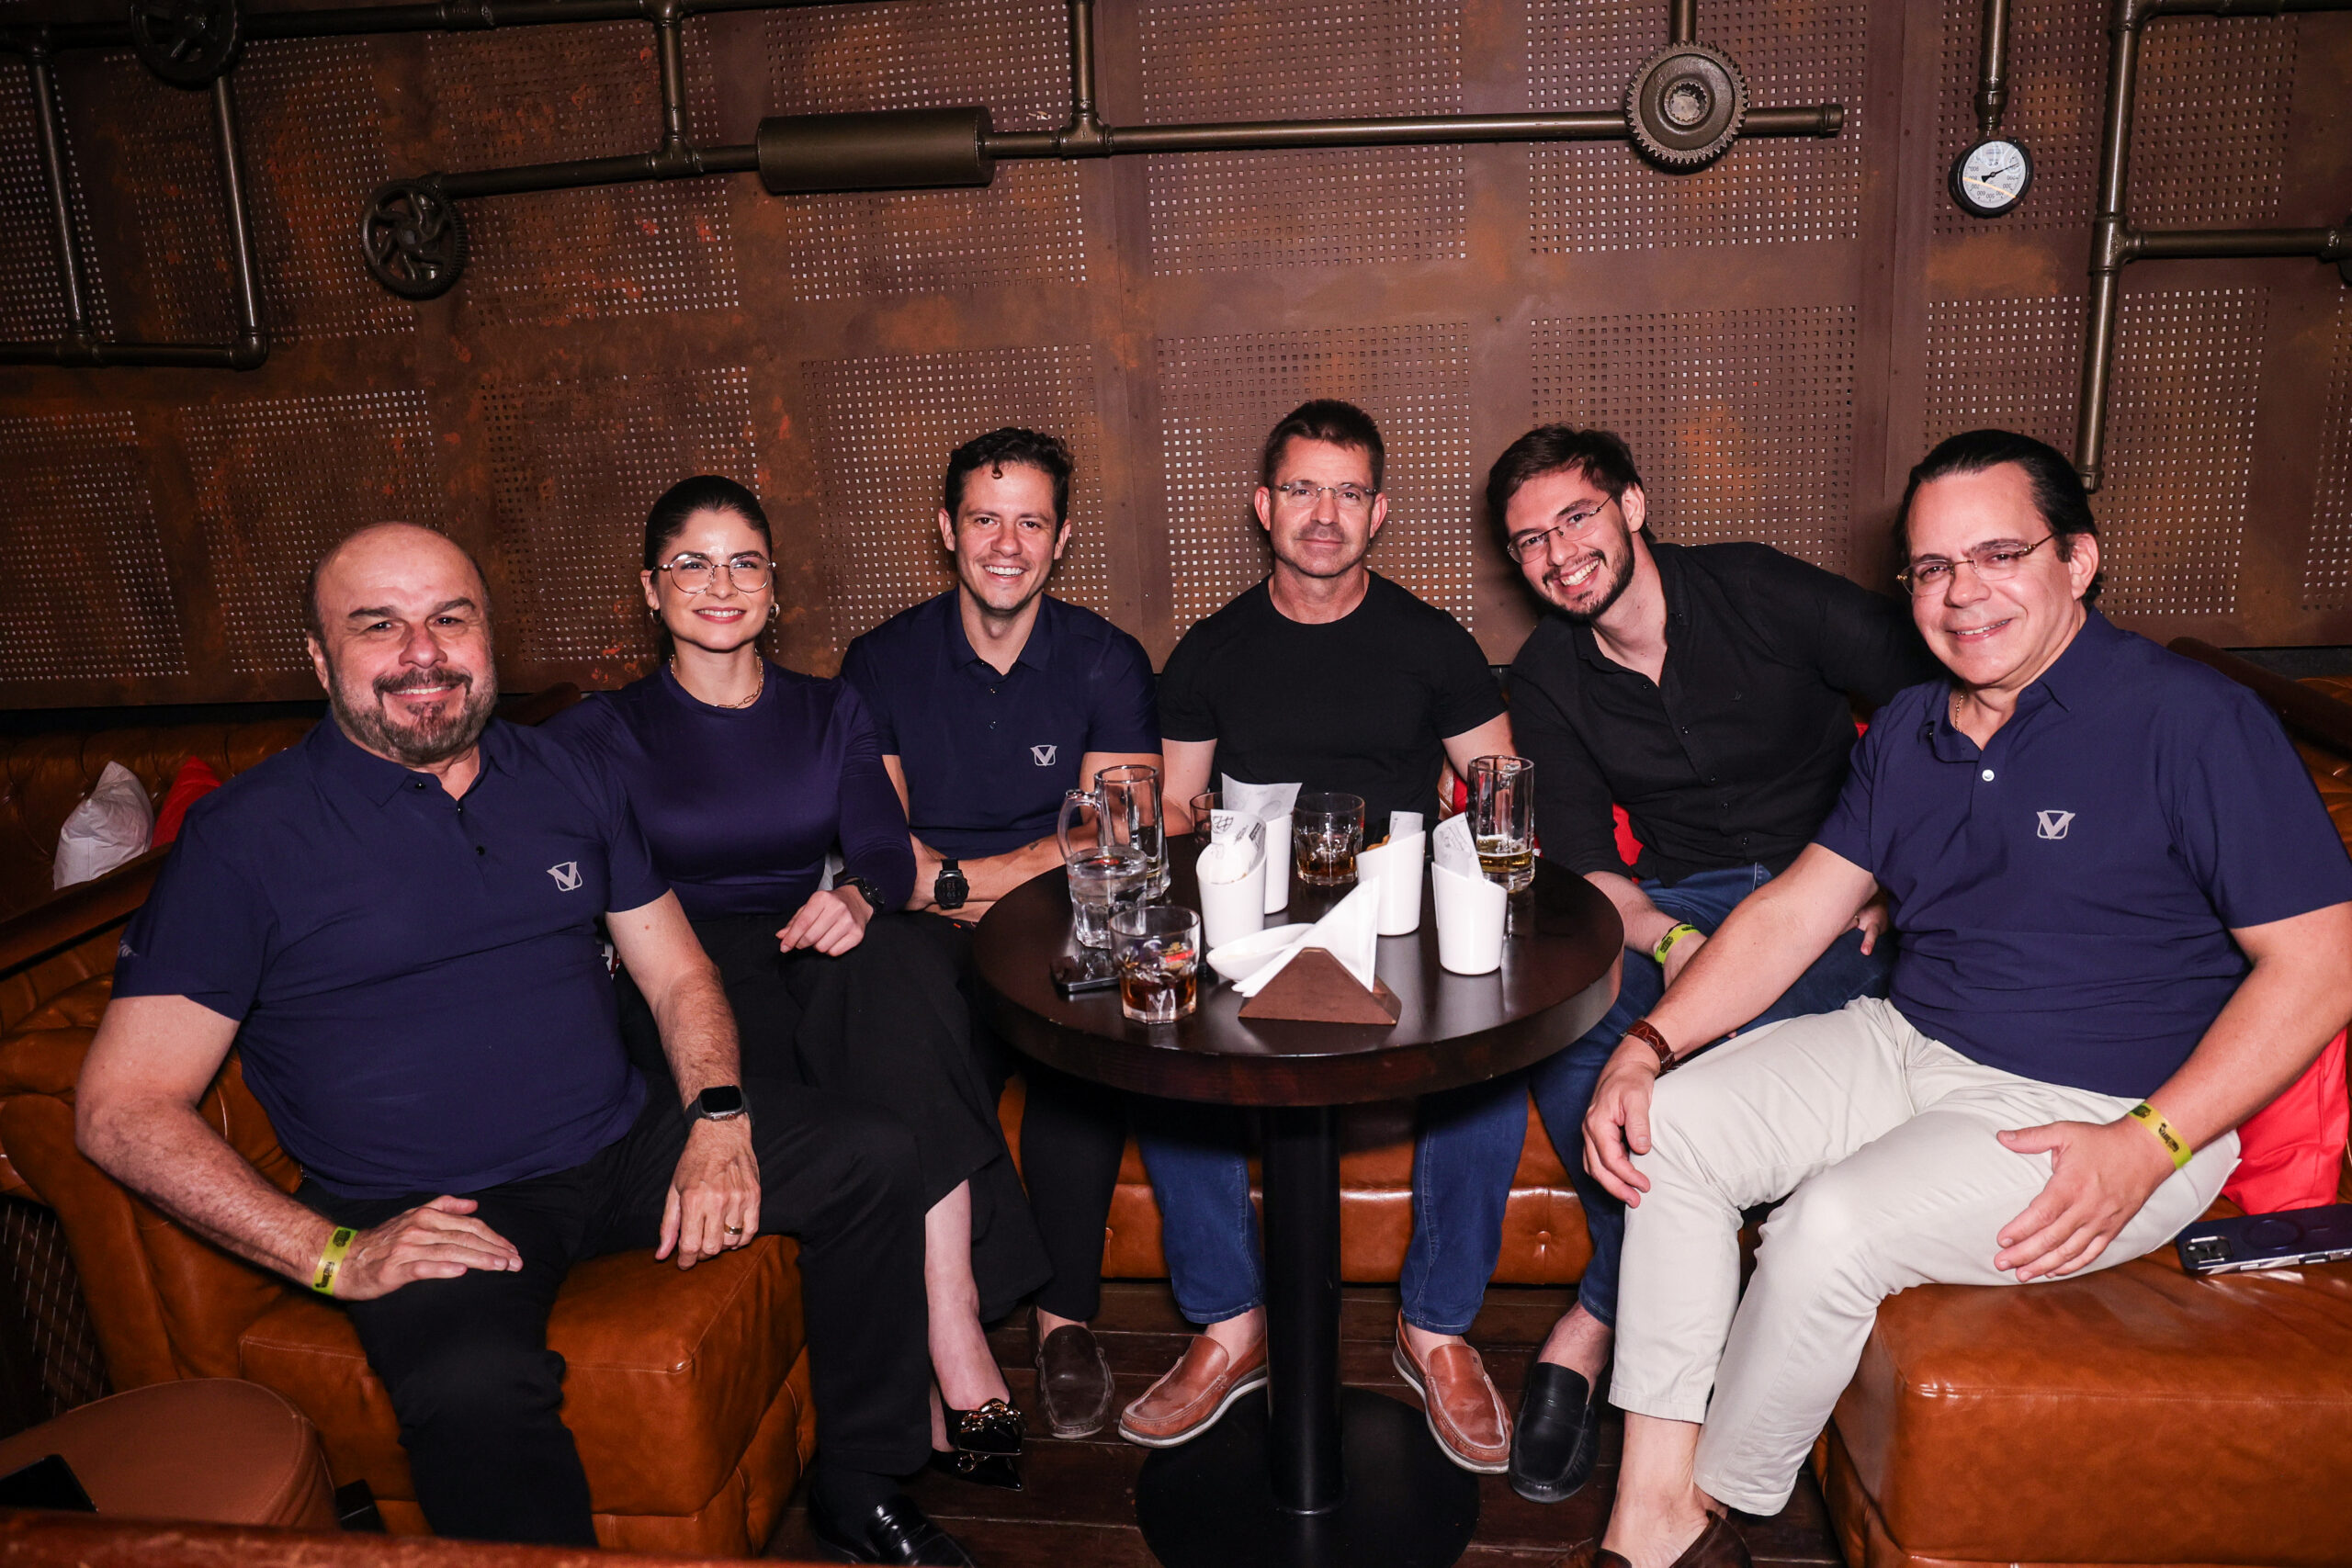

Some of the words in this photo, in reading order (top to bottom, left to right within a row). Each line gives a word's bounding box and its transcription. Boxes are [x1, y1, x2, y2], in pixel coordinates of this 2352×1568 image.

[1029, 744, 1057, 767] V
[2036, 810, 2076, 840] V
[546, 862, 581, 891] V
